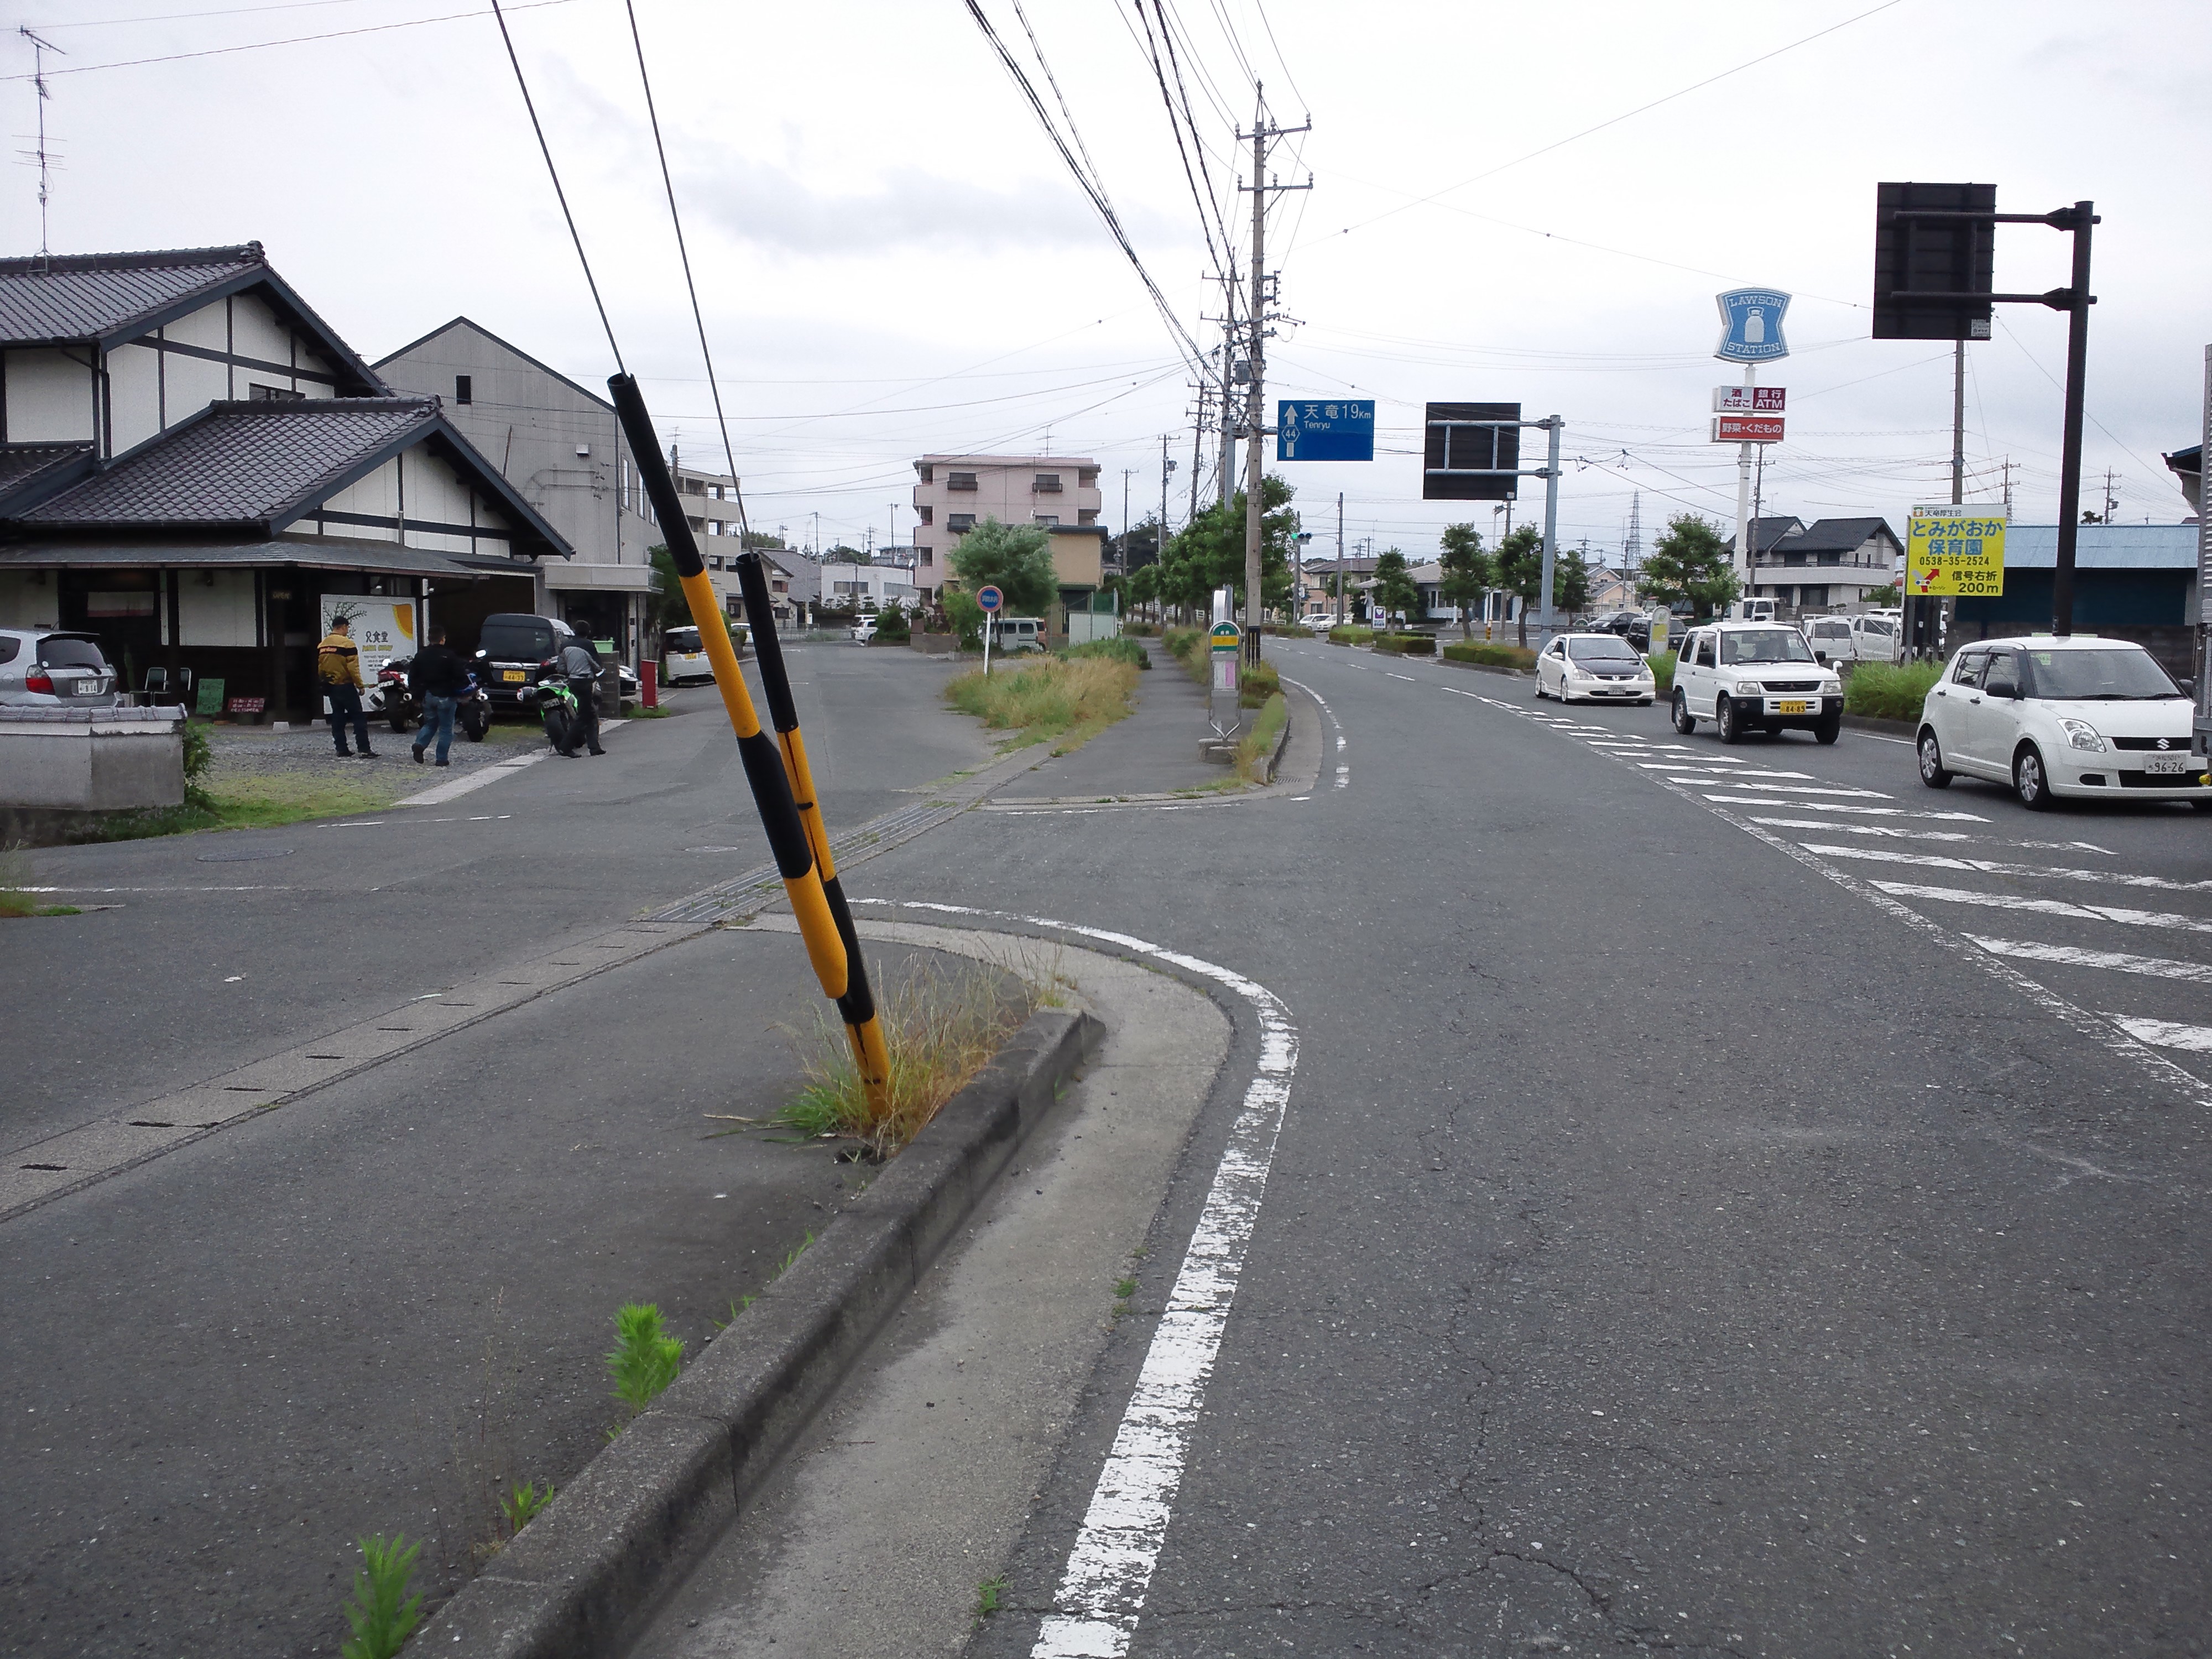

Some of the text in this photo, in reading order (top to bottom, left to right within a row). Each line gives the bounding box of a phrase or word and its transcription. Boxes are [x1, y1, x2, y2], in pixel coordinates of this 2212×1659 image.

[1729, 296, 1783, 307] LAWSON
[1726, 342, 1781, 354] STATION
[1731, 388, 1742, 398] 酒
[1757, 389, 1781, 399] 銀行
[1723, 398, 1750, 408] たばこ
[1755, 399, 1782, 409] ATM
[1304, 404, 1339, 419] 天竜
[1304, 421, 1330, 430] Tenryu
[1285, 429, 1296, 438] 44
[1913, 520, 2002, 537] とみがおか
[1928, 539, 1983, 555] 保育園
[1919, 556, 1989, 565] 0538-35-2524
[1952, 571, 1997, 581] 信号右折
